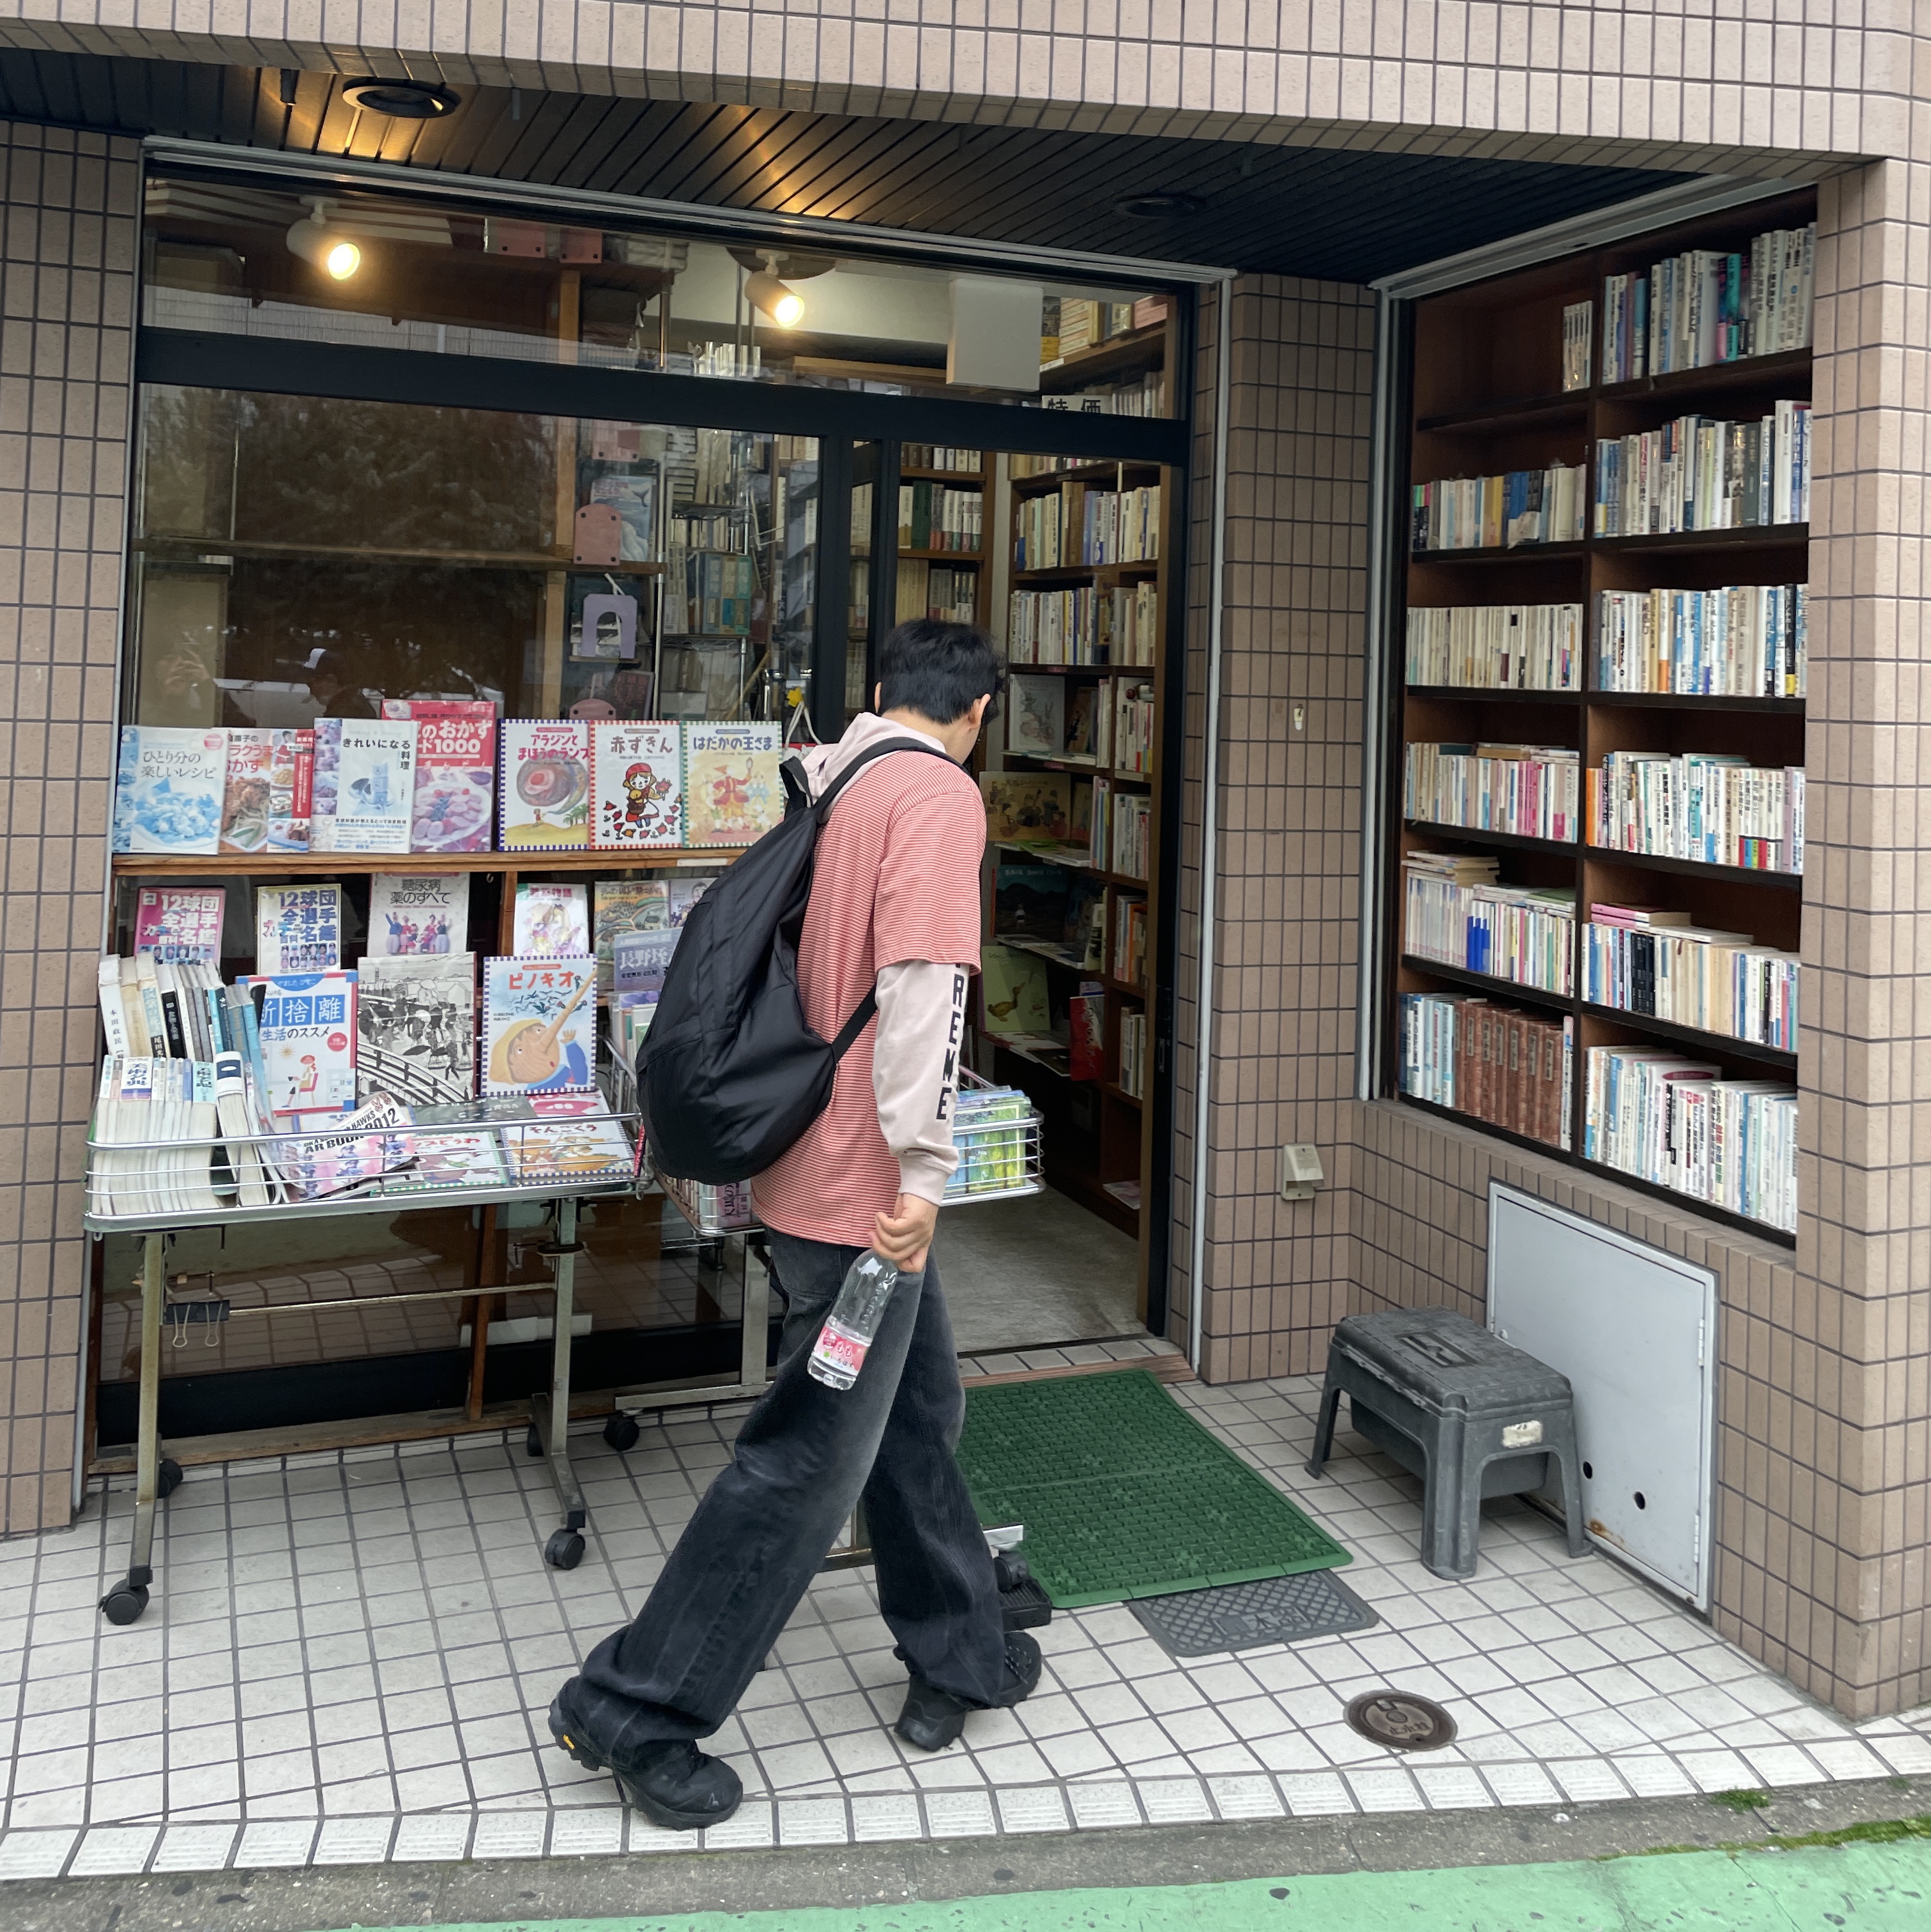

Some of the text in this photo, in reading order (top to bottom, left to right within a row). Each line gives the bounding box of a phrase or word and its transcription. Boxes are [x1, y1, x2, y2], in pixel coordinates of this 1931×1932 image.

[417, 720, 492, 739] のおかず
[342, 738, 411, 749] きれいになる
[531, 734, 577, 747] アラジンと
[611, 736, 673, 753] 赤ずきん
[693, 736, 772, 751] はだかの王さま
[143, 751, 201, 764] ひとり分の
[401, 751, 410, 770] 料理
[140, 765, 217, 779] 楽しいレシピ
[401, 878, 441, 891] 糖尿病
[162, 894, 220, 912] 12球団
[280, 890, 337, 907] 12球団
[390, 892, 451, 905] 薬のすべて
[162, 912, 217, 928] 全選手
[281, 907, 337, 924] 全選手
[179, 928, 217, 944] 名鑑
[300, 925, 337, 942] 名鑑
[509, 971, 574, 990] ピノキオ
[262, 1026, 329, 1041] 生活のススメ
[351, 1110, 376, 1129] HAWKS
[365, 1107, 399, 1128] 2012
